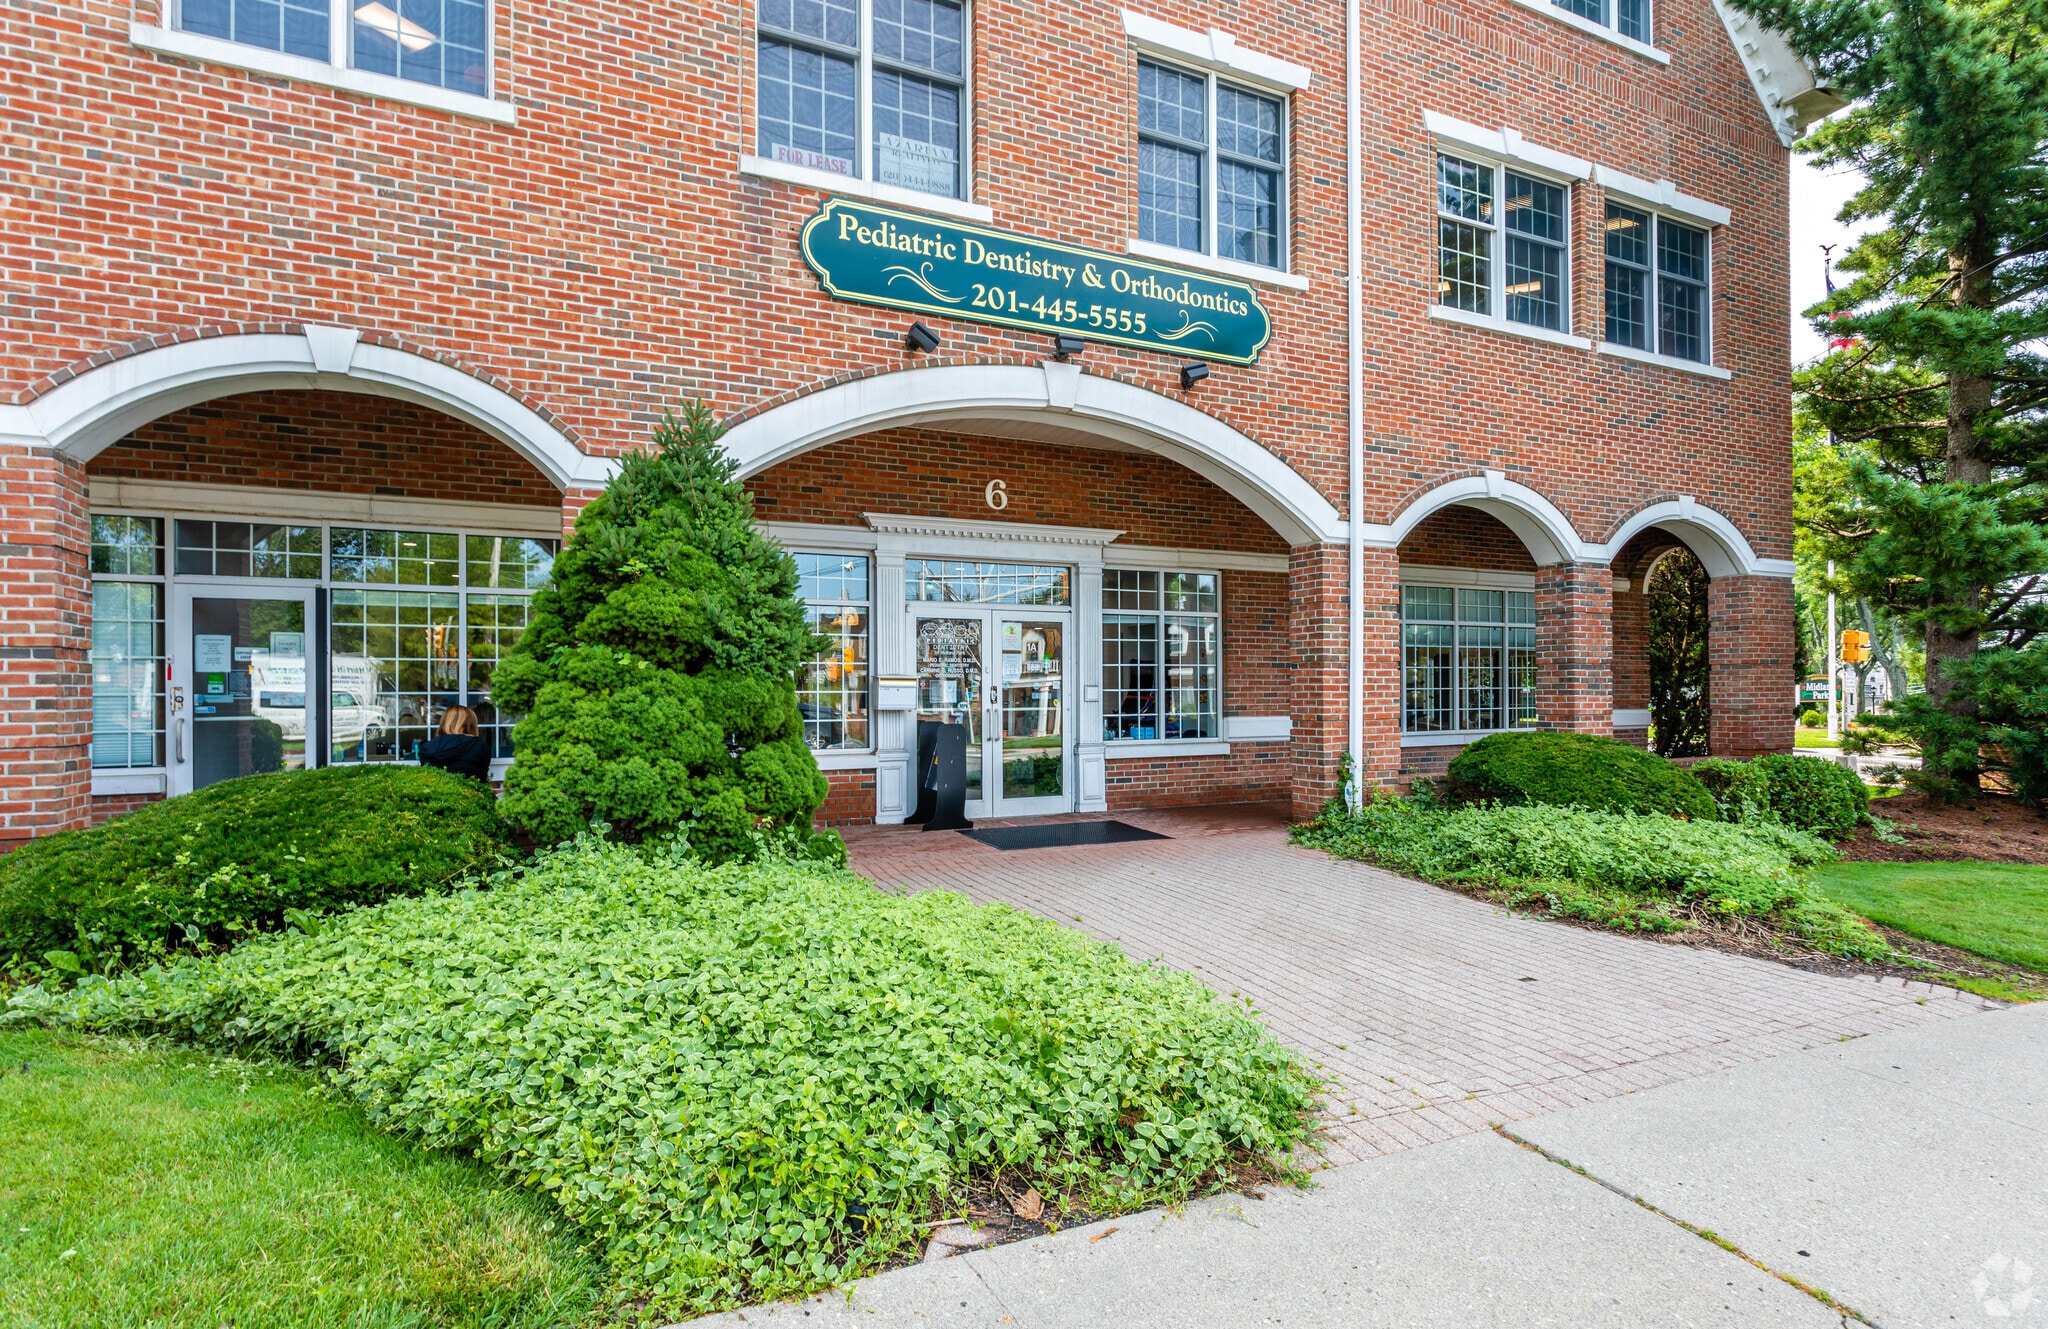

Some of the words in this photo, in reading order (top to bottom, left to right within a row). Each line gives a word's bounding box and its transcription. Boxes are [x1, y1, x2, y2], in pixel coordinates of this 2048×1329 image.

[778, 146, 804, 166] FOR
[808, 152, 848, 175] LEASE
[885, 136, 949, 160] AZARIAN
[837, 212, 957, 261] Pediatric
[962, 238, 1076, 288] Dentistry
[1081, 262, 1106, 289] &
[1110, 269, 1248, 317] Orthodontics
[971, 283, 1147, 334] 201-445-5555
[985, 479, 1008, 510] 6
[1027, 642, 1037, 652] 1A
[1806, 682, 1829, 691] Midla
